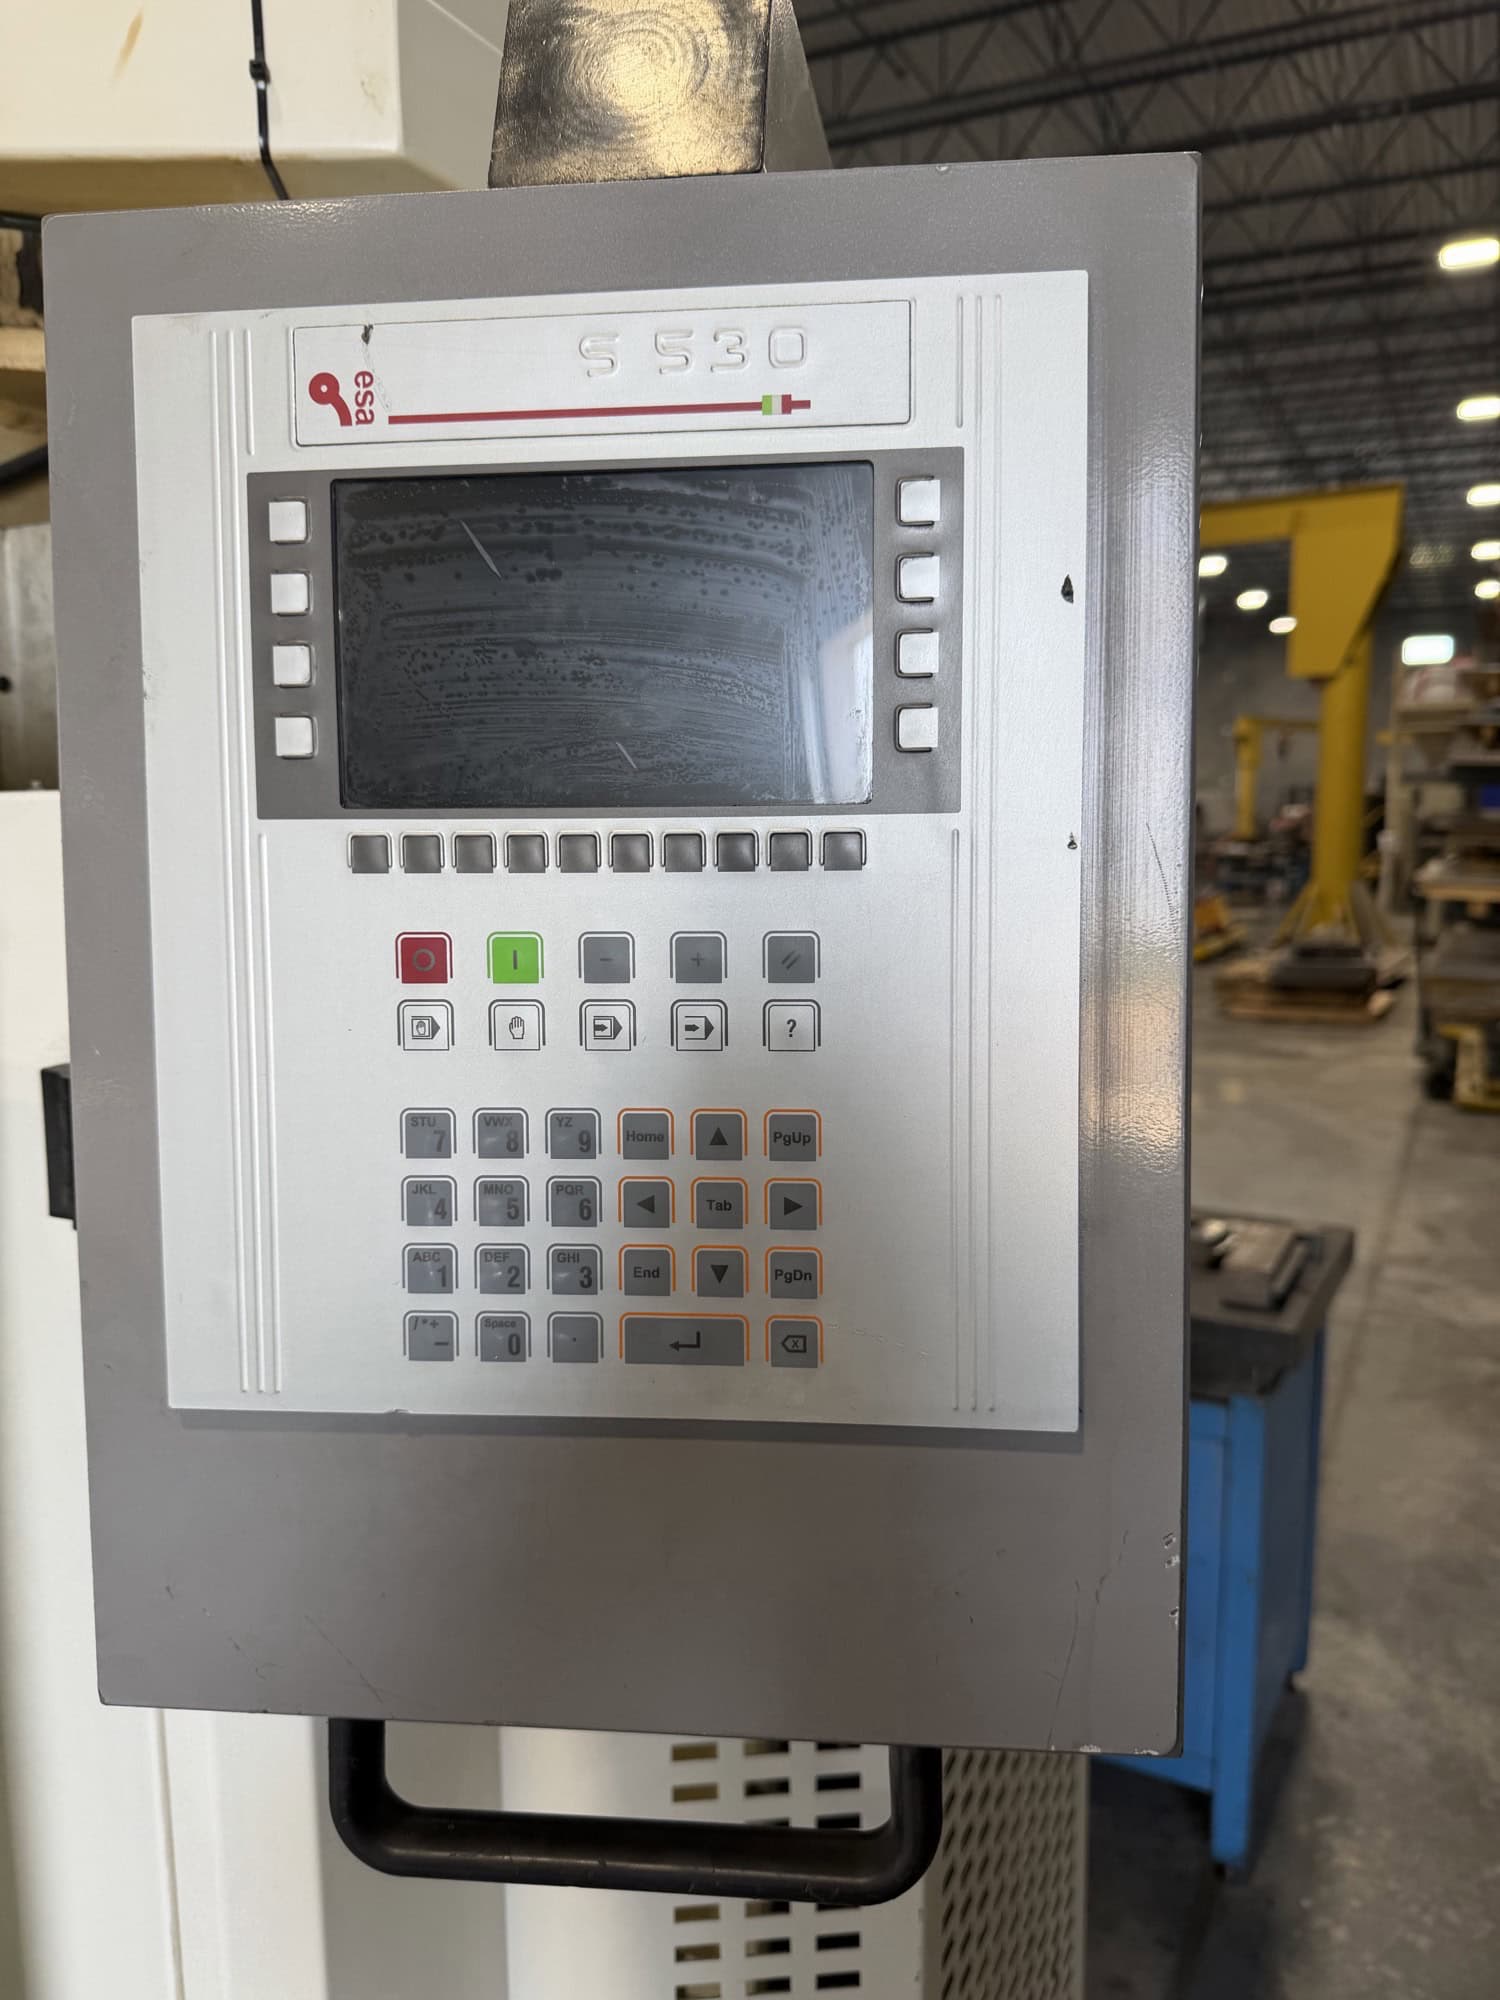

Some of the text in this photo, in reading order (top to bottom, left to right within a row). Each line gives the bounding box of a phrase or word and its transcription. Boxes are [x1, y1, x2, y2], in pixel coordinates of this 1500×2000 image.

[578, 326, 808, 378] S 530
[354, 370, 375, 426] esa
[786, 1018, 796, 1038] ?
[410, 1117, 436, 1127] STU
[484, 1117, 512, 1127] VWX
[556, 1117, 573, 1127] YZ
[433, 1130, 446, 1152] 7
[506, 1131, 518, 1152] 8
[578, 1130, 591, 1152] 9
[626, 1131, 664, 1143] Home
[773, 1132, 811, 1146] PgUp
[411, 1184, 436, 1194] JKL
[484, 1184, 513, 1194] MNO
[556, 1185, 584, 1196] PQR
[434, 1198, 447, 1219] 4
[506, 1199, 519, 1220] 5
[578, 1199, 592, 1221] 6
[706, 1200, 732, 1211] Tab
[413, 1252, 440, 1262] ABC
[484, 1252, 510, 1262] DEF
[557, 1252, 580, 1263] GHI
[438, 1266, 446, 1287] 1
[507, 1266, 520, 1287] 2
[579, 1266, 592, 1288] 3
[633, 1267, 660, 1278] End
[774, 1269, 812, 1283] PgDn
[484, 1319, 516, 1329] Space
[508, 1334, 520, 1355] 0
